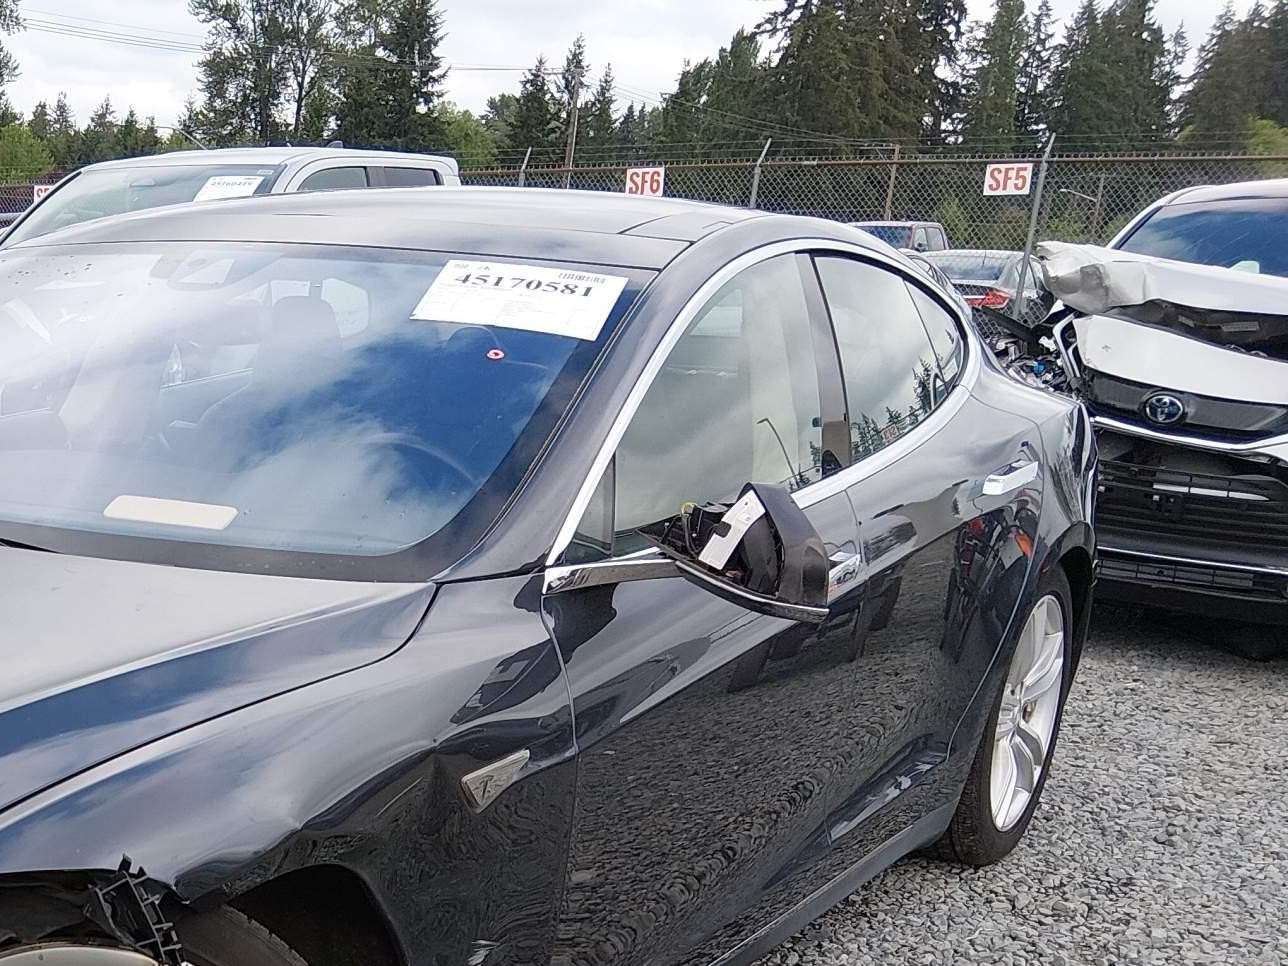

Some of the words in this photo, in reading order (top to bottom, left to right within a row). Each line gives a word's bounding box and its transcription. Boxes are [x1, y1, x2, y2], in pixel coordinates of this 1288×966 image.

[628, 170, 661, 195] SF6
[988, 166, 1028, 192] SF5
[454, 272, 594, 298] 45170581
